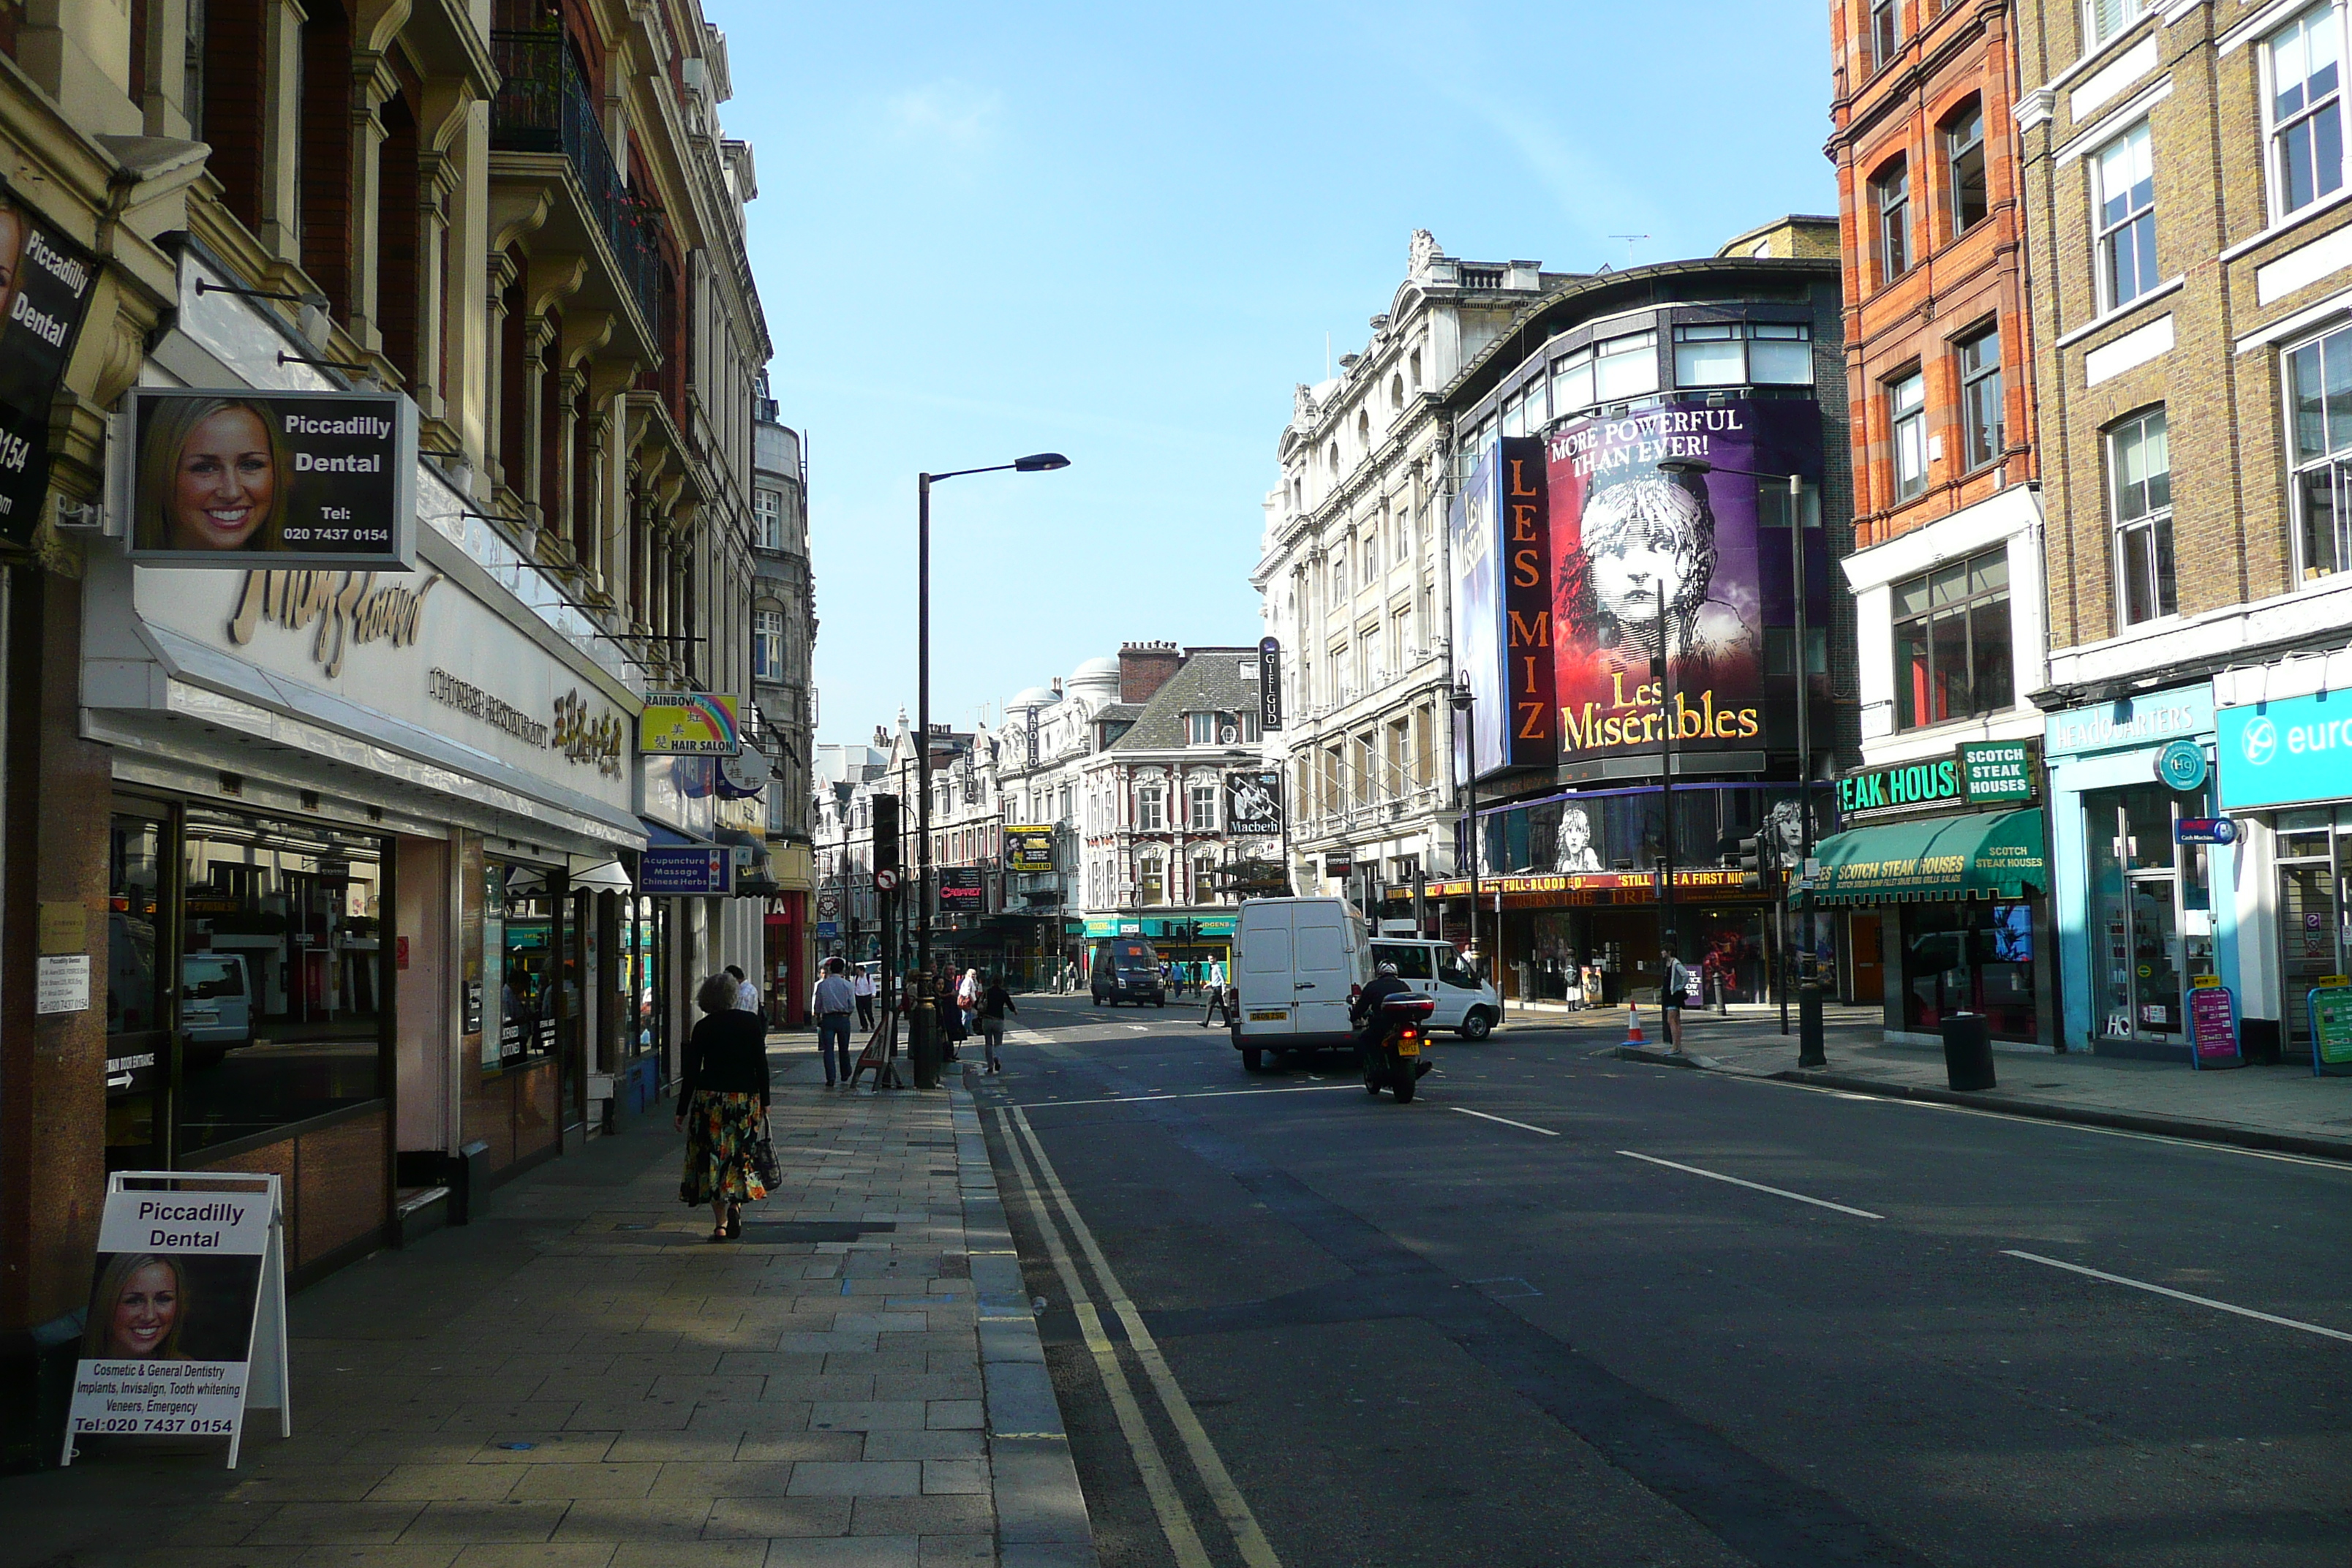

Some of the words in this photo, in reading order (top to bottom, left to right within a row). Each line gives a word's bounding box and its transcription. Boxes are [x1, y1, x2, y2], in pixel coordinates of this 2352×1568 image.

[26, 230, 88, 299] Piccadilly
[11, 291, 68, 348] Dental
[285, 415, 391, 440] Piccadilly
[1551, 427, 1599, 463] MORE
[1605, 410, 1743, 442] POWERFUL
[295, 453, 380, 472] Dental
[1572, 445, 1632, 478] THAN
[1637, 435, 1709, 464] EVER!
[320, 506, 351, 520] Tel:
[1510, 459, 1539, 587] LES
[284, 528, 311, 540] 020
[314, 528, 350, 540] 7437
[353, 529, 388, 540] 0154
[1508, 610, 1549, 739] MIZ
[1265, 653, 1277, 724] GIELGUD
[1612, 672, 1662, 709] Les
[430, 666, 486, 719] CHINESE
[486, 694, 549, 751] RESTAURANT
[646, 695, 696, 706] RAINBOW
[671, 740, 697, 751] HAIR
[699, 740, 734, 751] SALON
[1029, 714, 1039, 766] APOLLO
[1967, 748, 2024, 764] SCOTCH
[966, 755, 974, 801] LYRIC
[1972, 764, 2021, 778] STEAK
[1890, 761, 1960, 804] HOUS
[1970, 779, 2026, 794] HOUSES
[1989, 847, 2028, 856] SCOTCH
[643, 857, 706, 866] Acupuncture
[1838, 862, 1880, 880] SCOTCH
[1882, 858, 1918, 878] STEAK
[1918, 855, 1965, 875] HOUSES
[1975, 859, 2005, 868] STEAK
[2007, 857, 2043, 867] HOUSES
[654, 867, 698, 877] Massage
[1681, 873, 1689, 885] A
[1692, 871, 1723, 885] FIRST
[642, 878, 679, 886] Chinese
[680, 878, 708, 886] Herbs
[1516, 890, 1556, 907] QUEEN'S
[75, 998, 88, 1009] 0154
[138, 1202, 245, 1226] Piccadilly
[149, 1229, 219, 1248] Dental
[94, 1362, 137, 1376] Cosmetic
[137, 1363, 145, 1376] &
[148, 1364, 183, 1377] General
[184, 1365, 225, 1380] Dentistry
[78, 1381, 118, 1396] Implants,
[121, 1382, 167, 1397] Invisalign,
[170, 1382, 195, 1395] Tooth
[197, 1383, 241, 1398] whitening
[106, 1399, 145, 1414] Veneers,
[146, 1400, 198, 1415] Emergency
[75, 1418, 138, 1432] Tel:020
[144, 1419, 186, 1432] 7437
[190, 1419, 233, 1433] 0154
